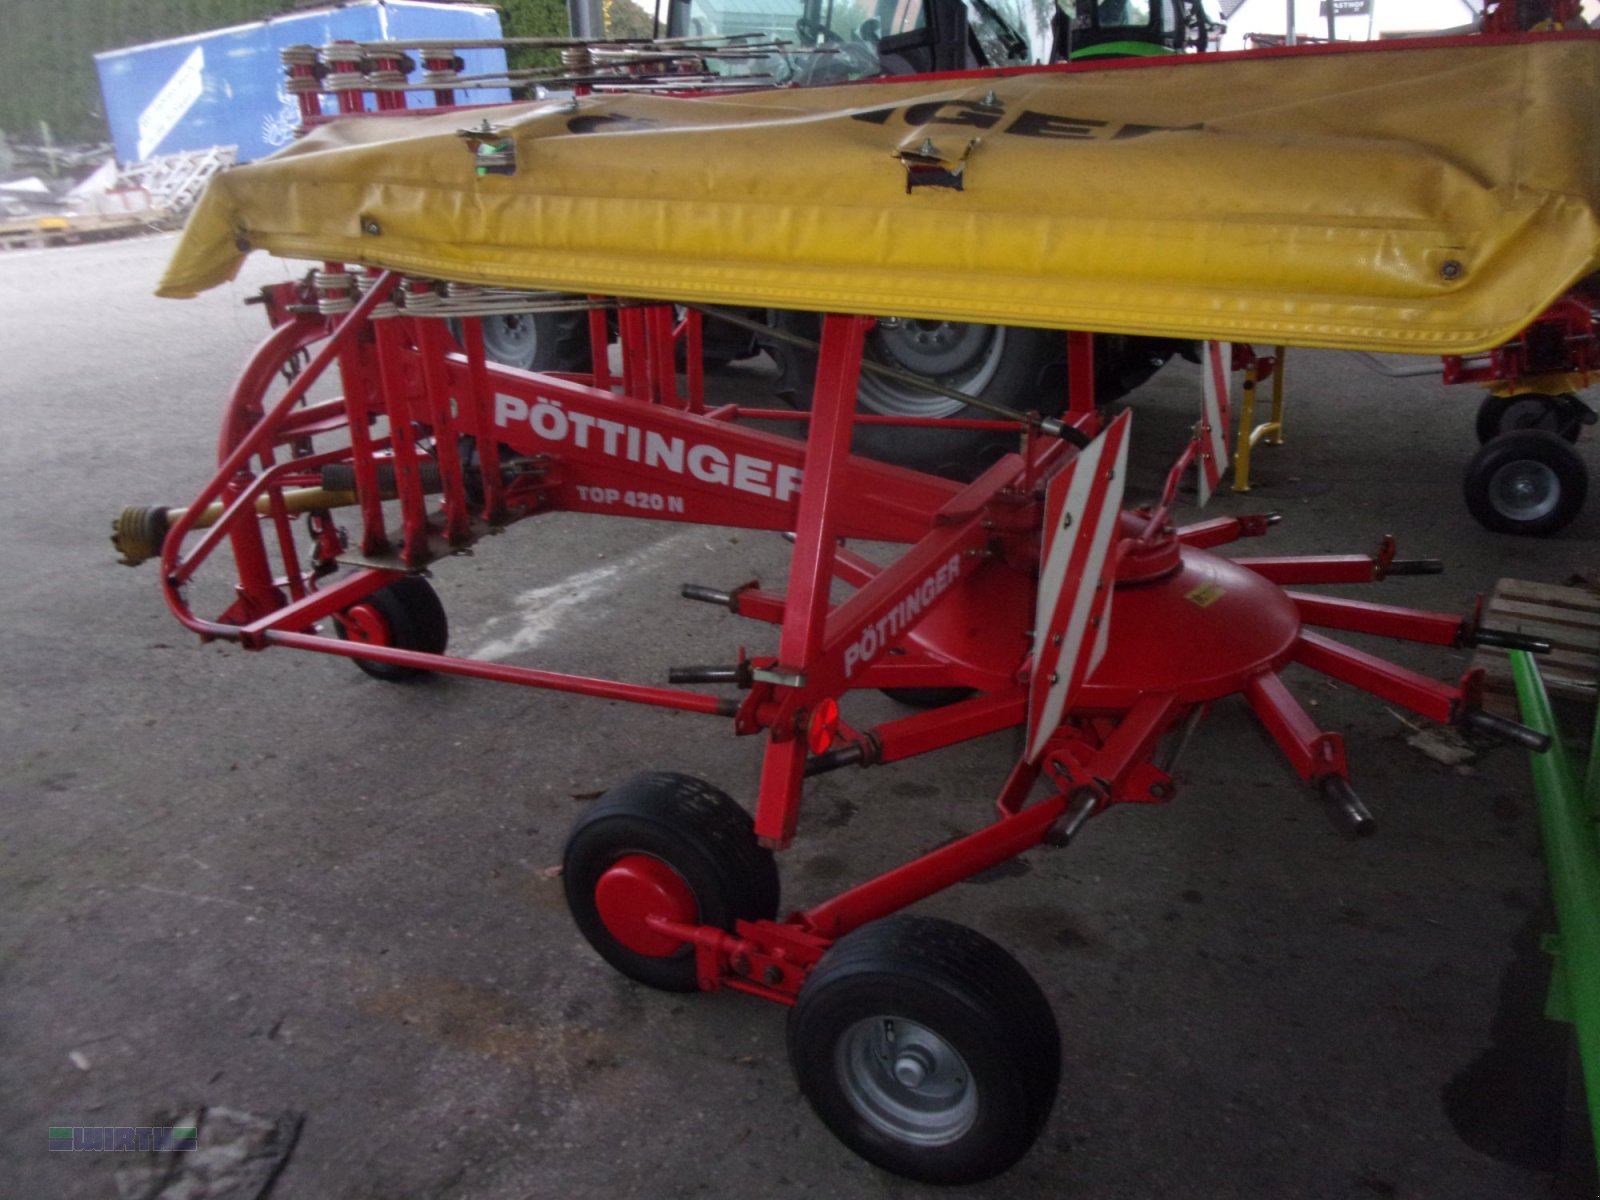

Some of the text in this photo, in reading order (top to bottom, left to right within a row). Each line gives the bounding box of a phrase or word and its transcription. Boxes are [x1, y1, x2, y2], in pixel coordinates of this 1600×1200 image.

[576, 485, 684, 513] TOP 420 N
[844, 554, 960, 678] PÖTTINGER
